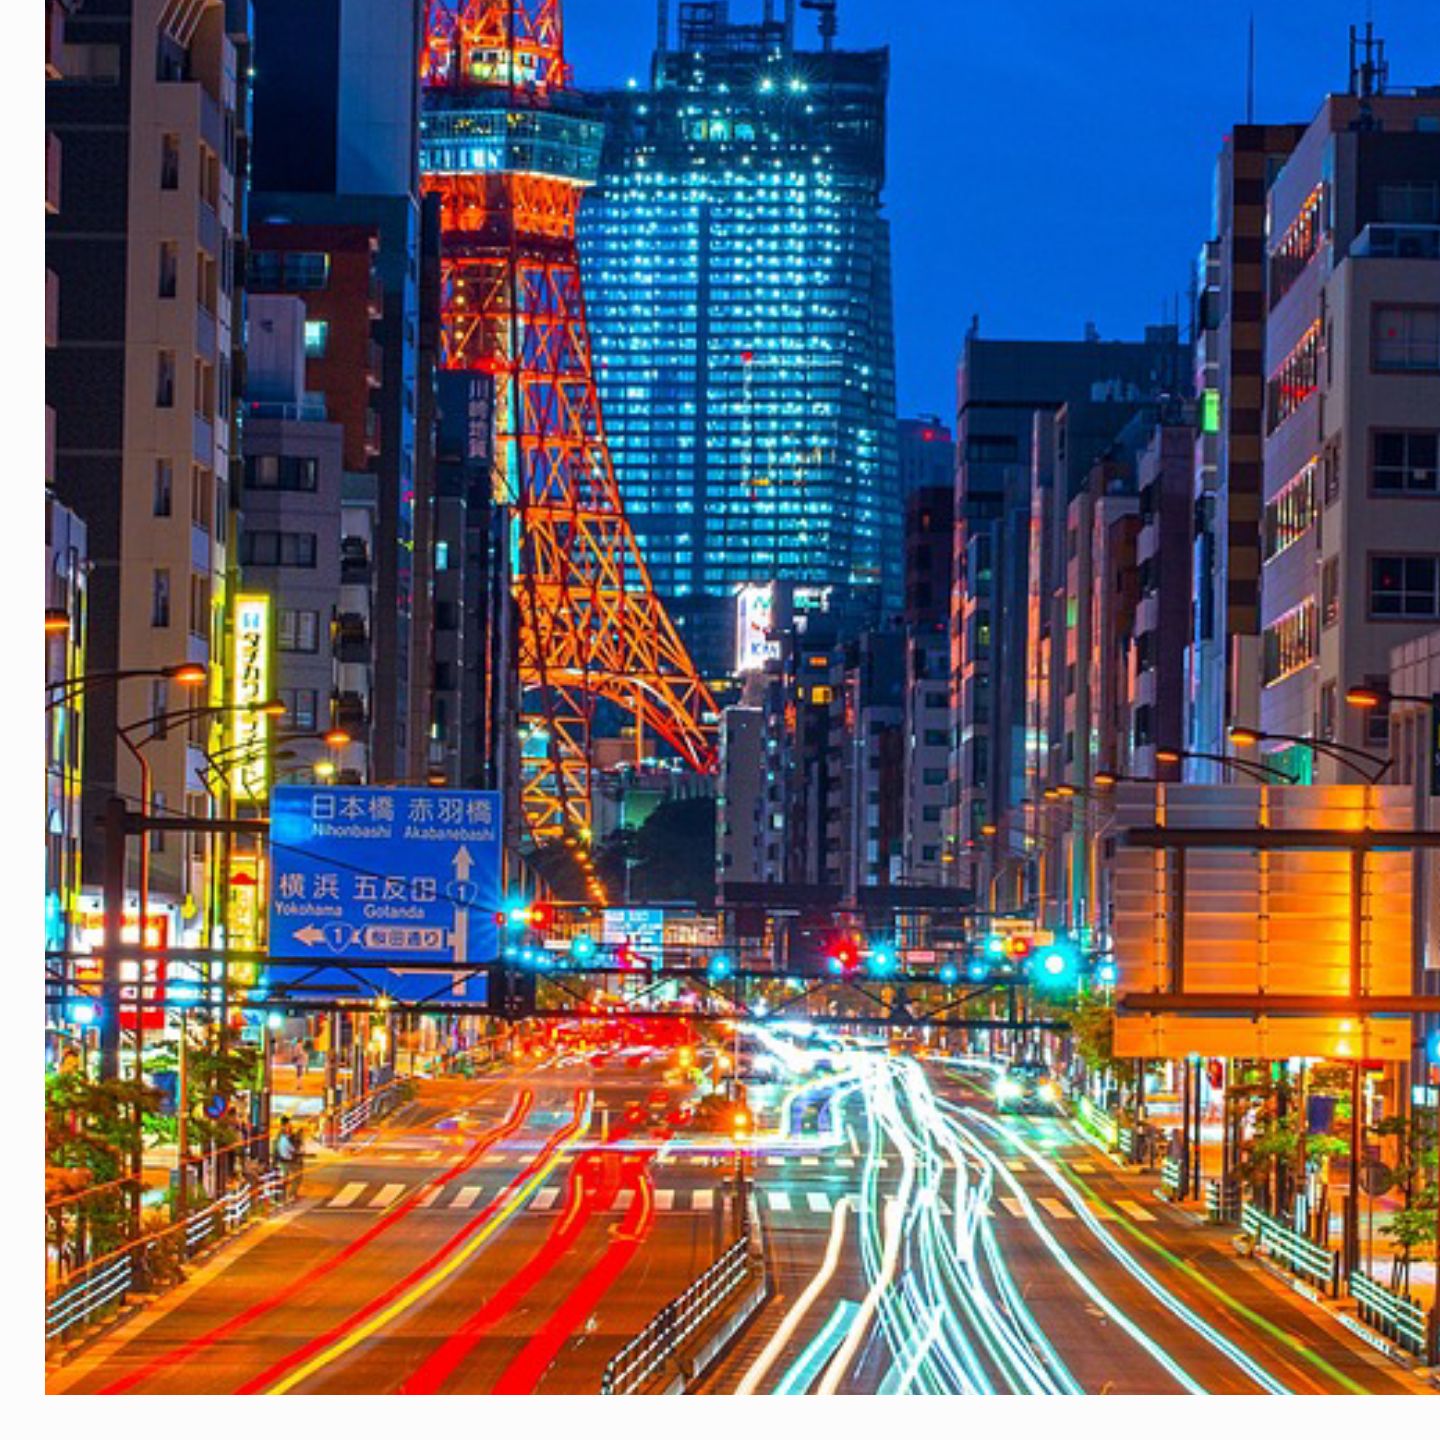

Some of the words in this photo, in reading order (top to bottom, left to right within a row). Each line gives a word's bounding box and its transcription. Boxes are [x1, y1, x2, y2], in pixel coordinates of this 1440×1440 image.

[312, 795, 394, 822] 日本橋
[408, 797, 492, 825] 赤羽橋
[312, 823, 392, 838] Nihonbashi
[404, 825, 495, 841] Akabanebashi
[279, 873, 339, 900] 横浜
[352, 875, 436, 902] 五反田
[275, 901, 342, 917] Yokohama
[363, 904, 425, 919] Gotanda
[333, 928, 343, 944] 1
